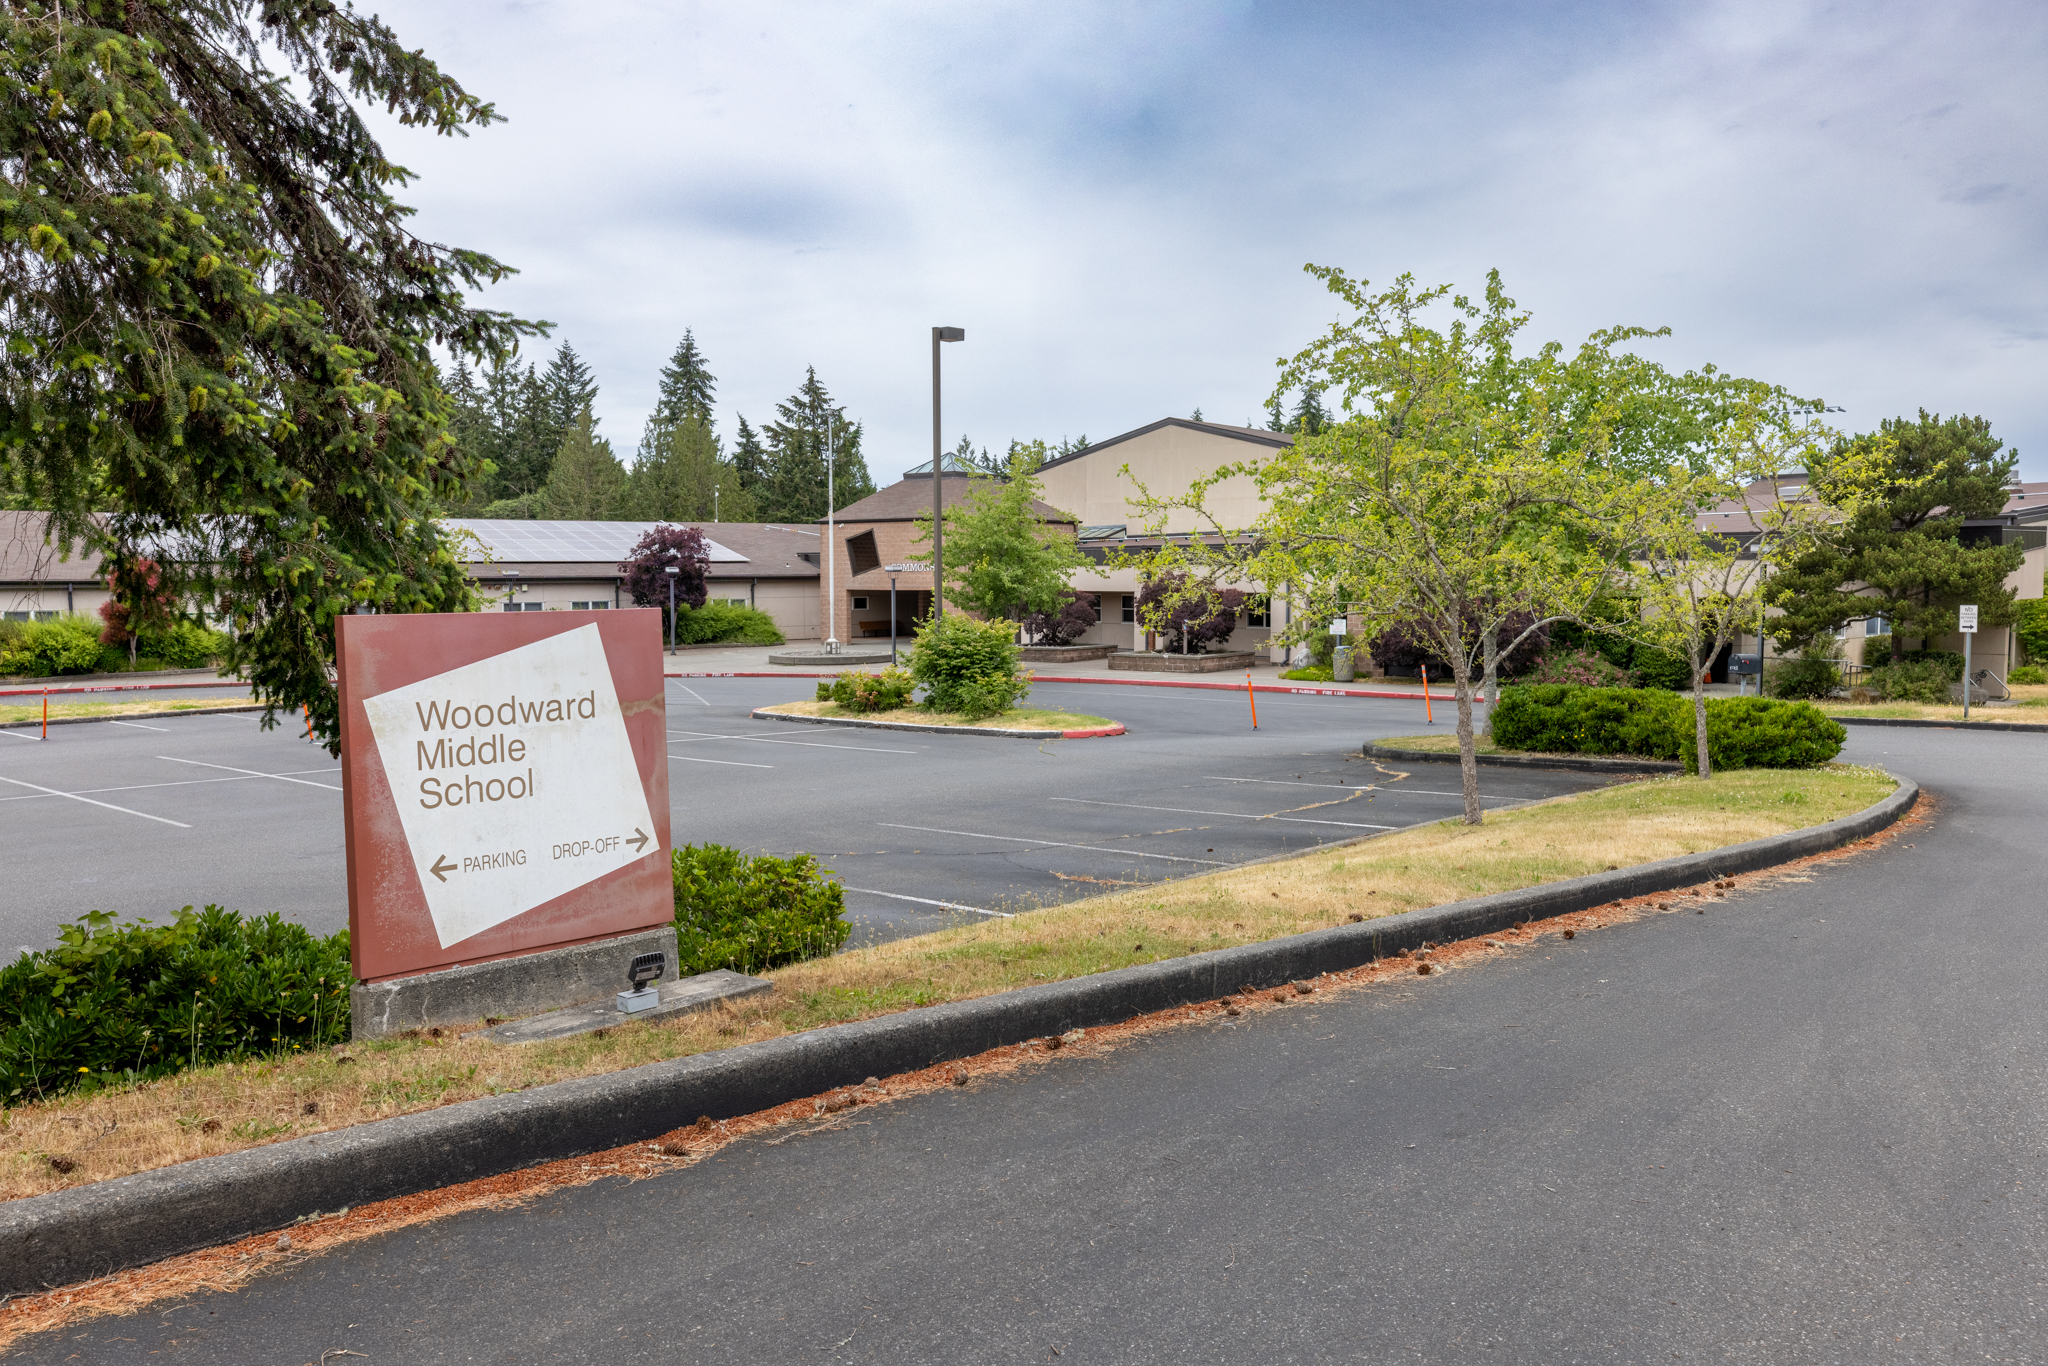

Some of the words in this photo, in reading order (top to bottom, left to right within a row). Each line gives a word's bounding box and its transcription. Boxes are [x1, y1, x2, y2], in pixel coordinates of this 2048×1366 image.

[416, 690, 596, 731] Woodward
[417, 734, 526, 770] Middle
[420, 768, 534, 809] School
[463, 849, 527, 873] PARKING
[552, 836, 620, 859] DROP-OFF
